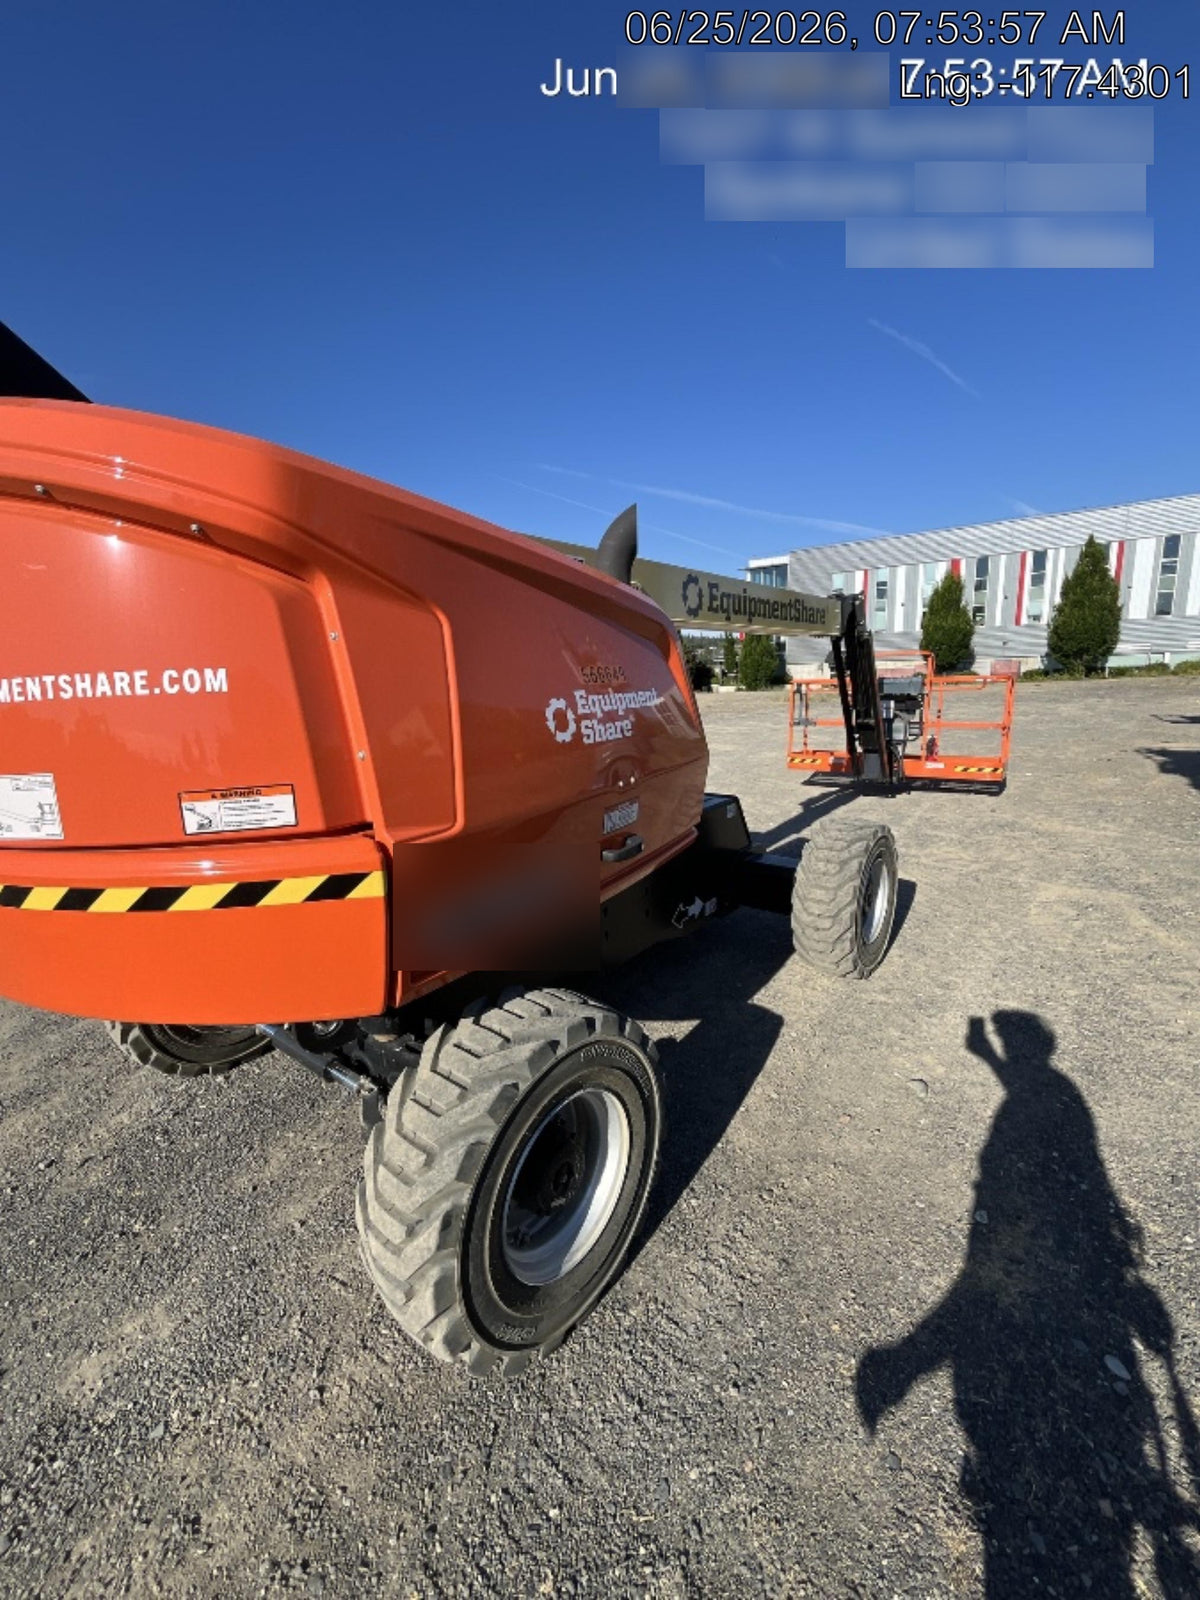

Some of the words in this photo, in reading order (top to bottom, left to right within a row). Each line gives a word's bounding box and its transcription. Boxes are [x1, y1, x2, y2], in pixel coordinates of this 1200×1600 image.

[707, 581, 826, 624] EquipmentShare
[574, 687, 660, 718] Equipment
[580, 719, 633, 745] Share
